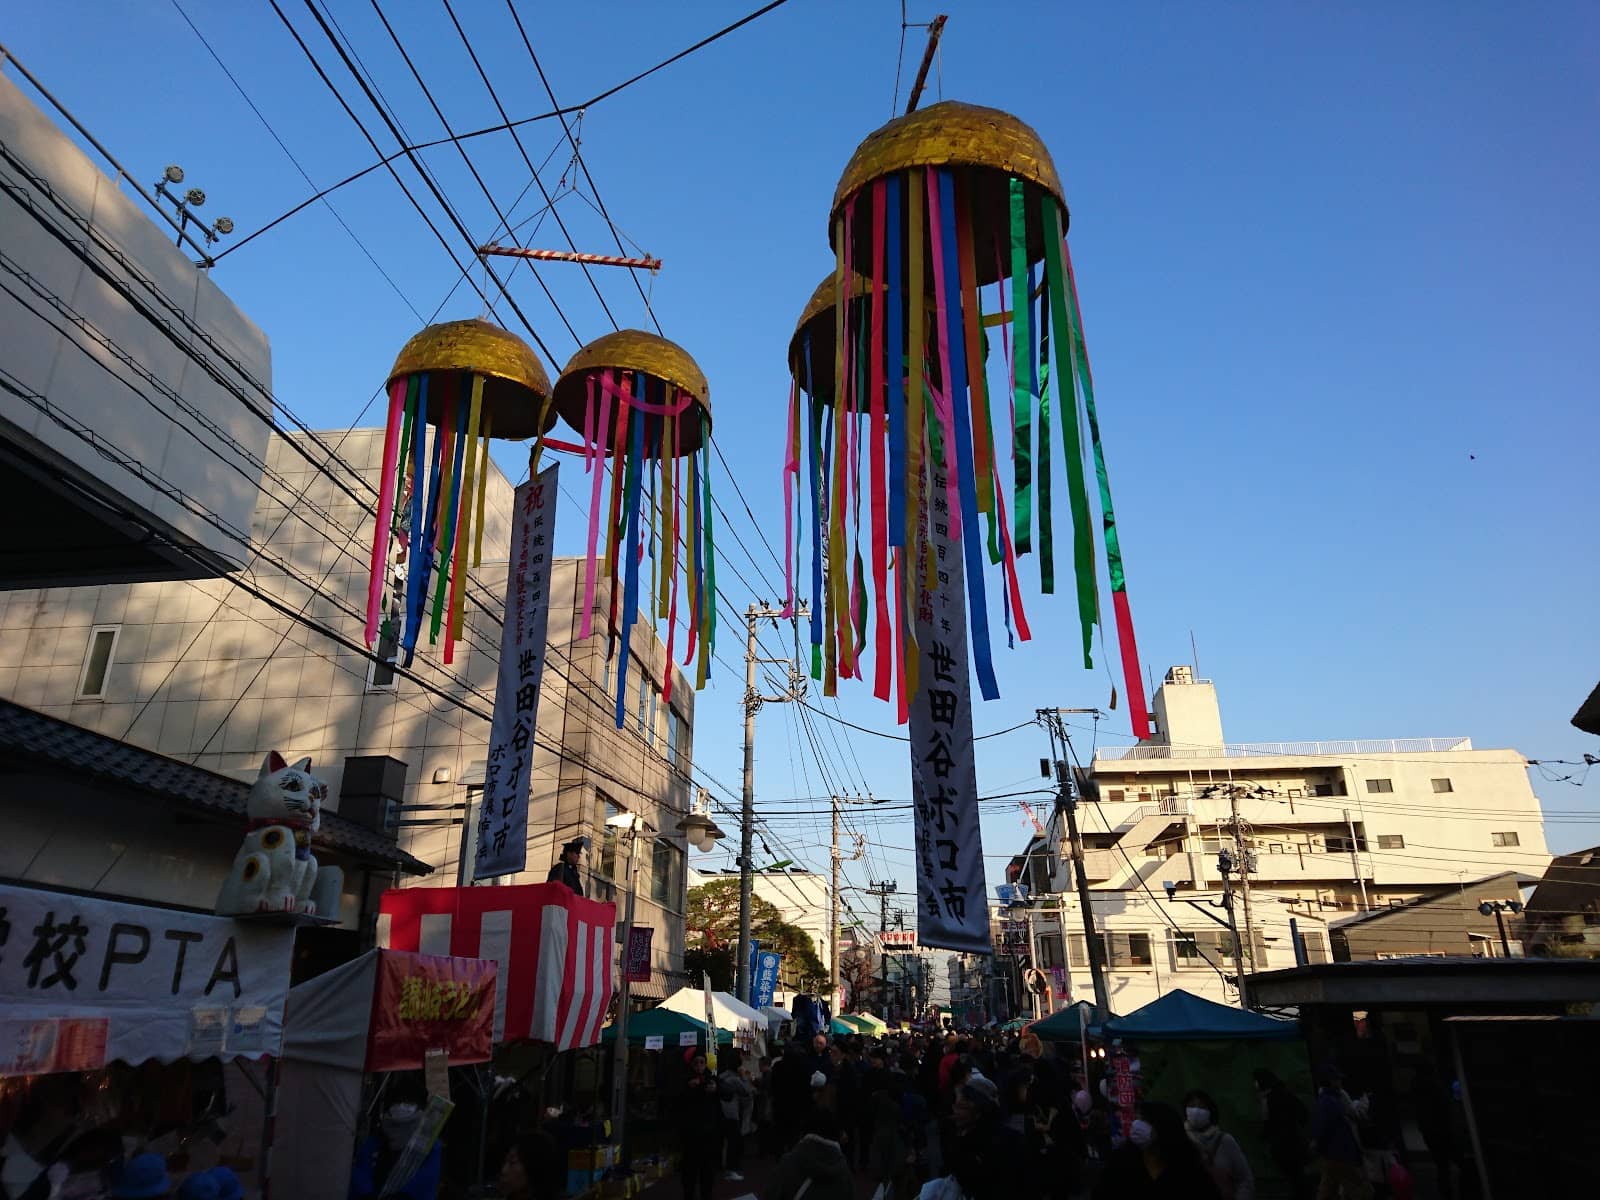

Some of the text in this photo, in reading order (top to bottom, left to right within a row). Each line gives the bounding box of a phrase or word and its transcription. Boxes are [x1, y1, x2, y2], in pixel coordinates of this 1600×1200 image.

[523, 484, 545, 516] 祝
[923, 640, 967, 926] 世田谷ボロ市
[0, 905, 242, 999] 校PTA
